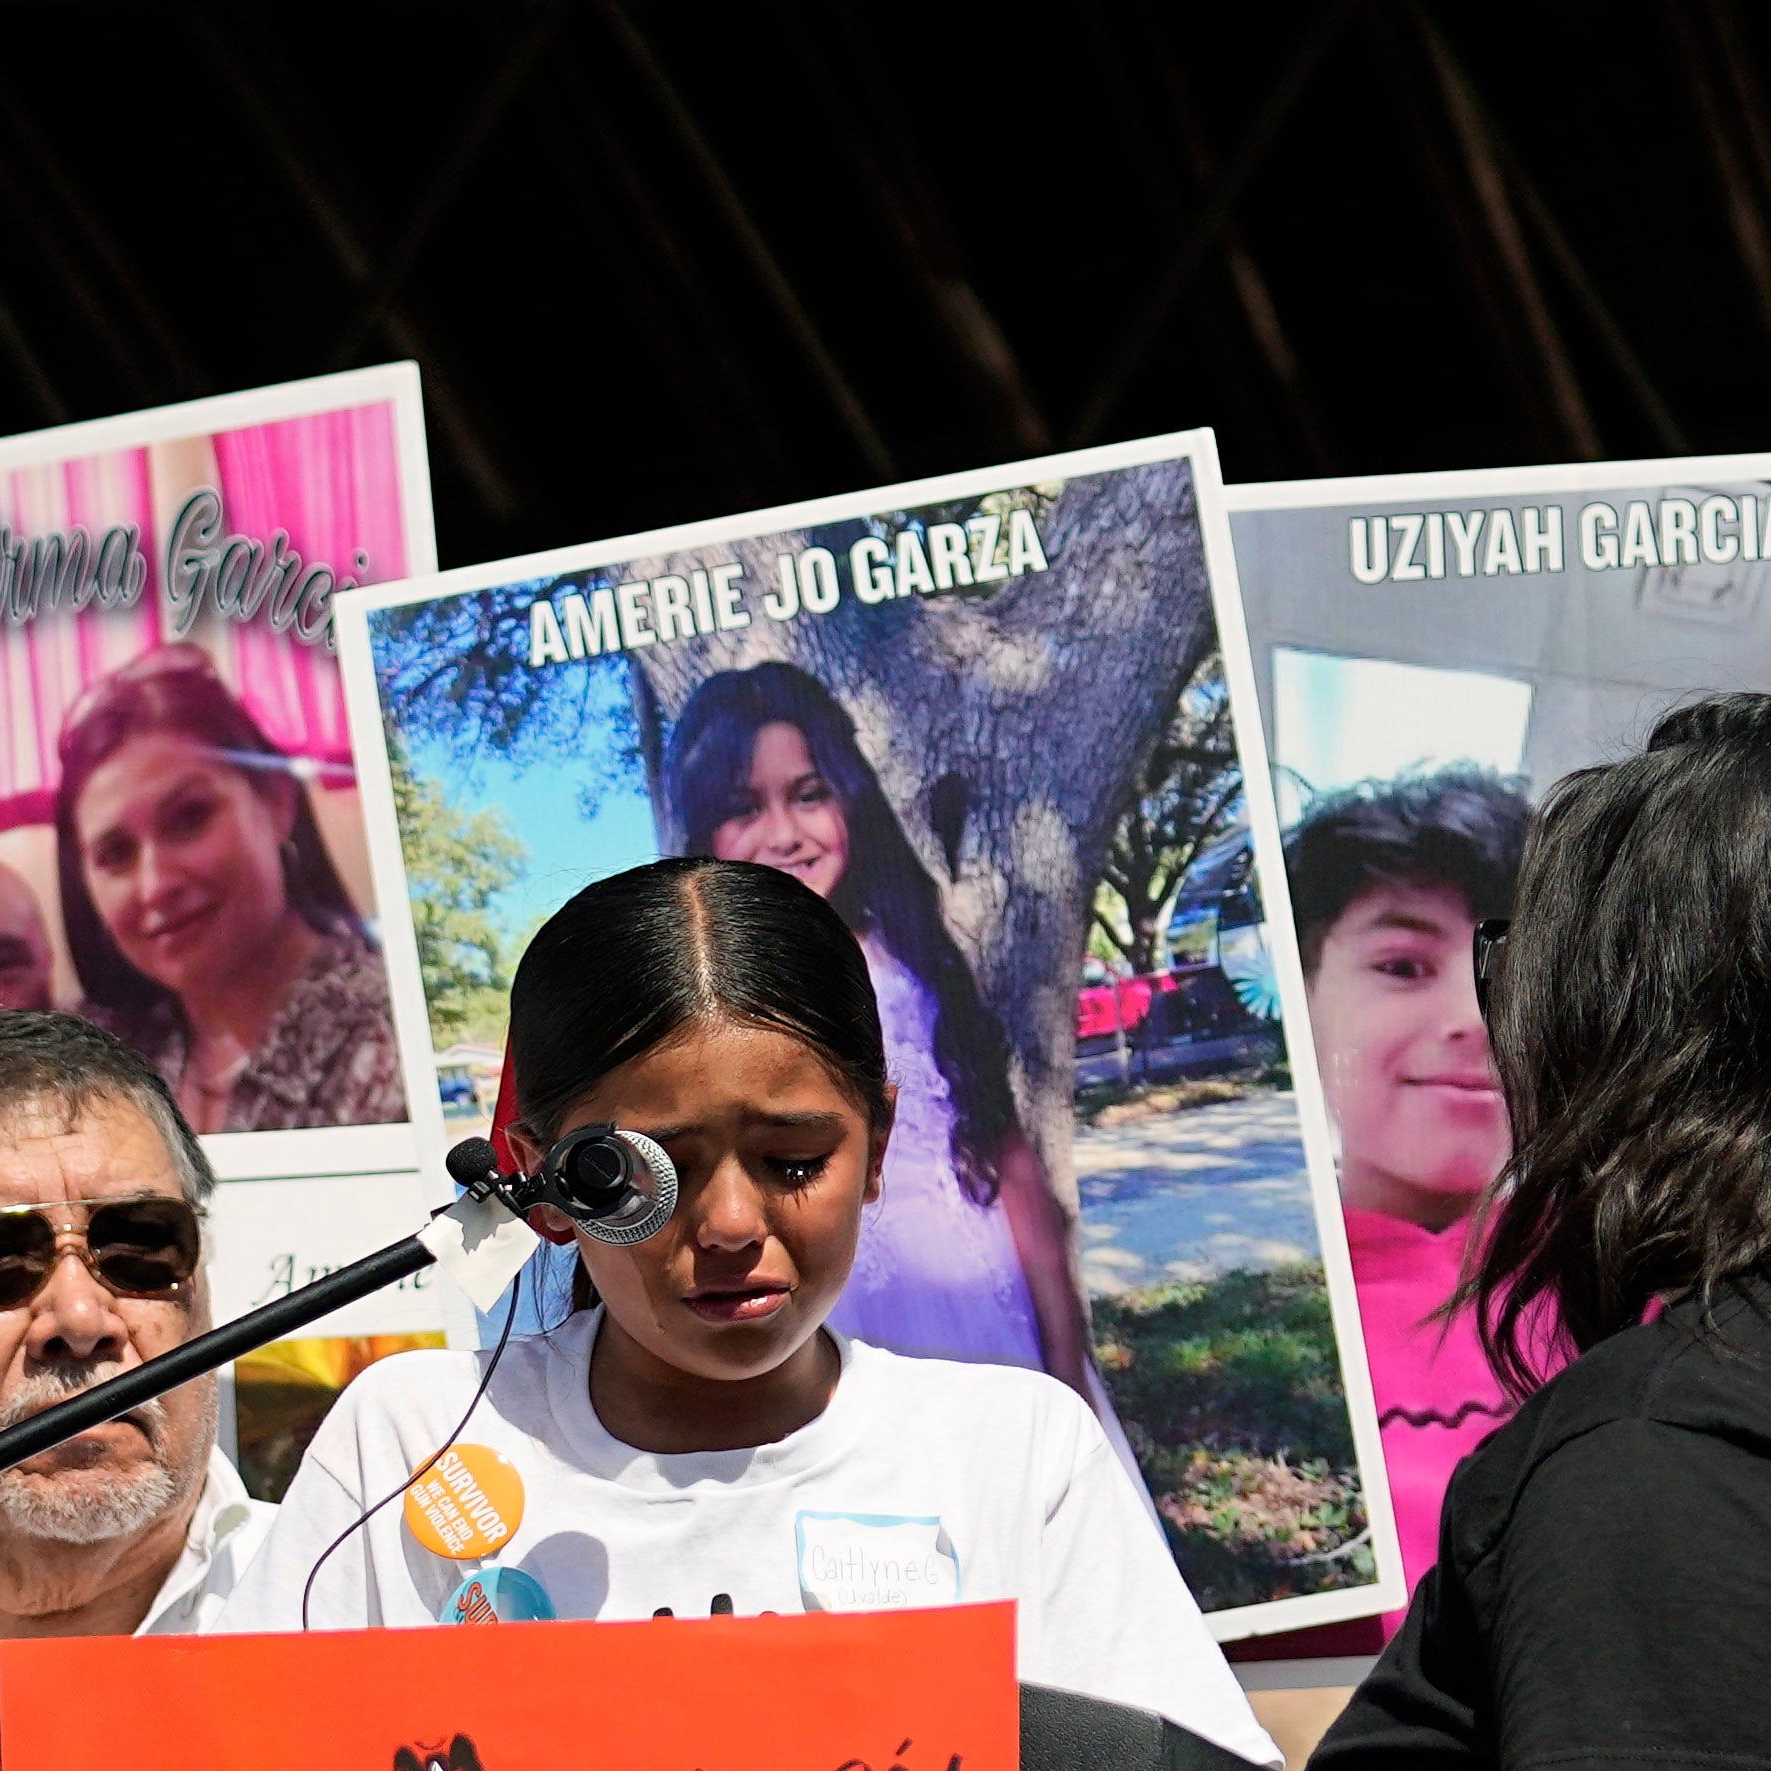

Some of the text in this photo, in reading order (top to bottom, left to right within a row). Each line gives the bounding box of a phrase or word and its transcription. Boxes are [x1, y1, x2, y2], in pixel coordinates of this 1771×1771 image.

[1349, 506, 1564, 585] UZIYAH
[530, 509, 1048, 668] AMERIE JO GARZA
[410, 1483, 466, 1555] GUN VIOLENCE
[426, 1479, 474, 1542] WE CAN END
[436, 1452, 508, 1544] SURVIVOR
